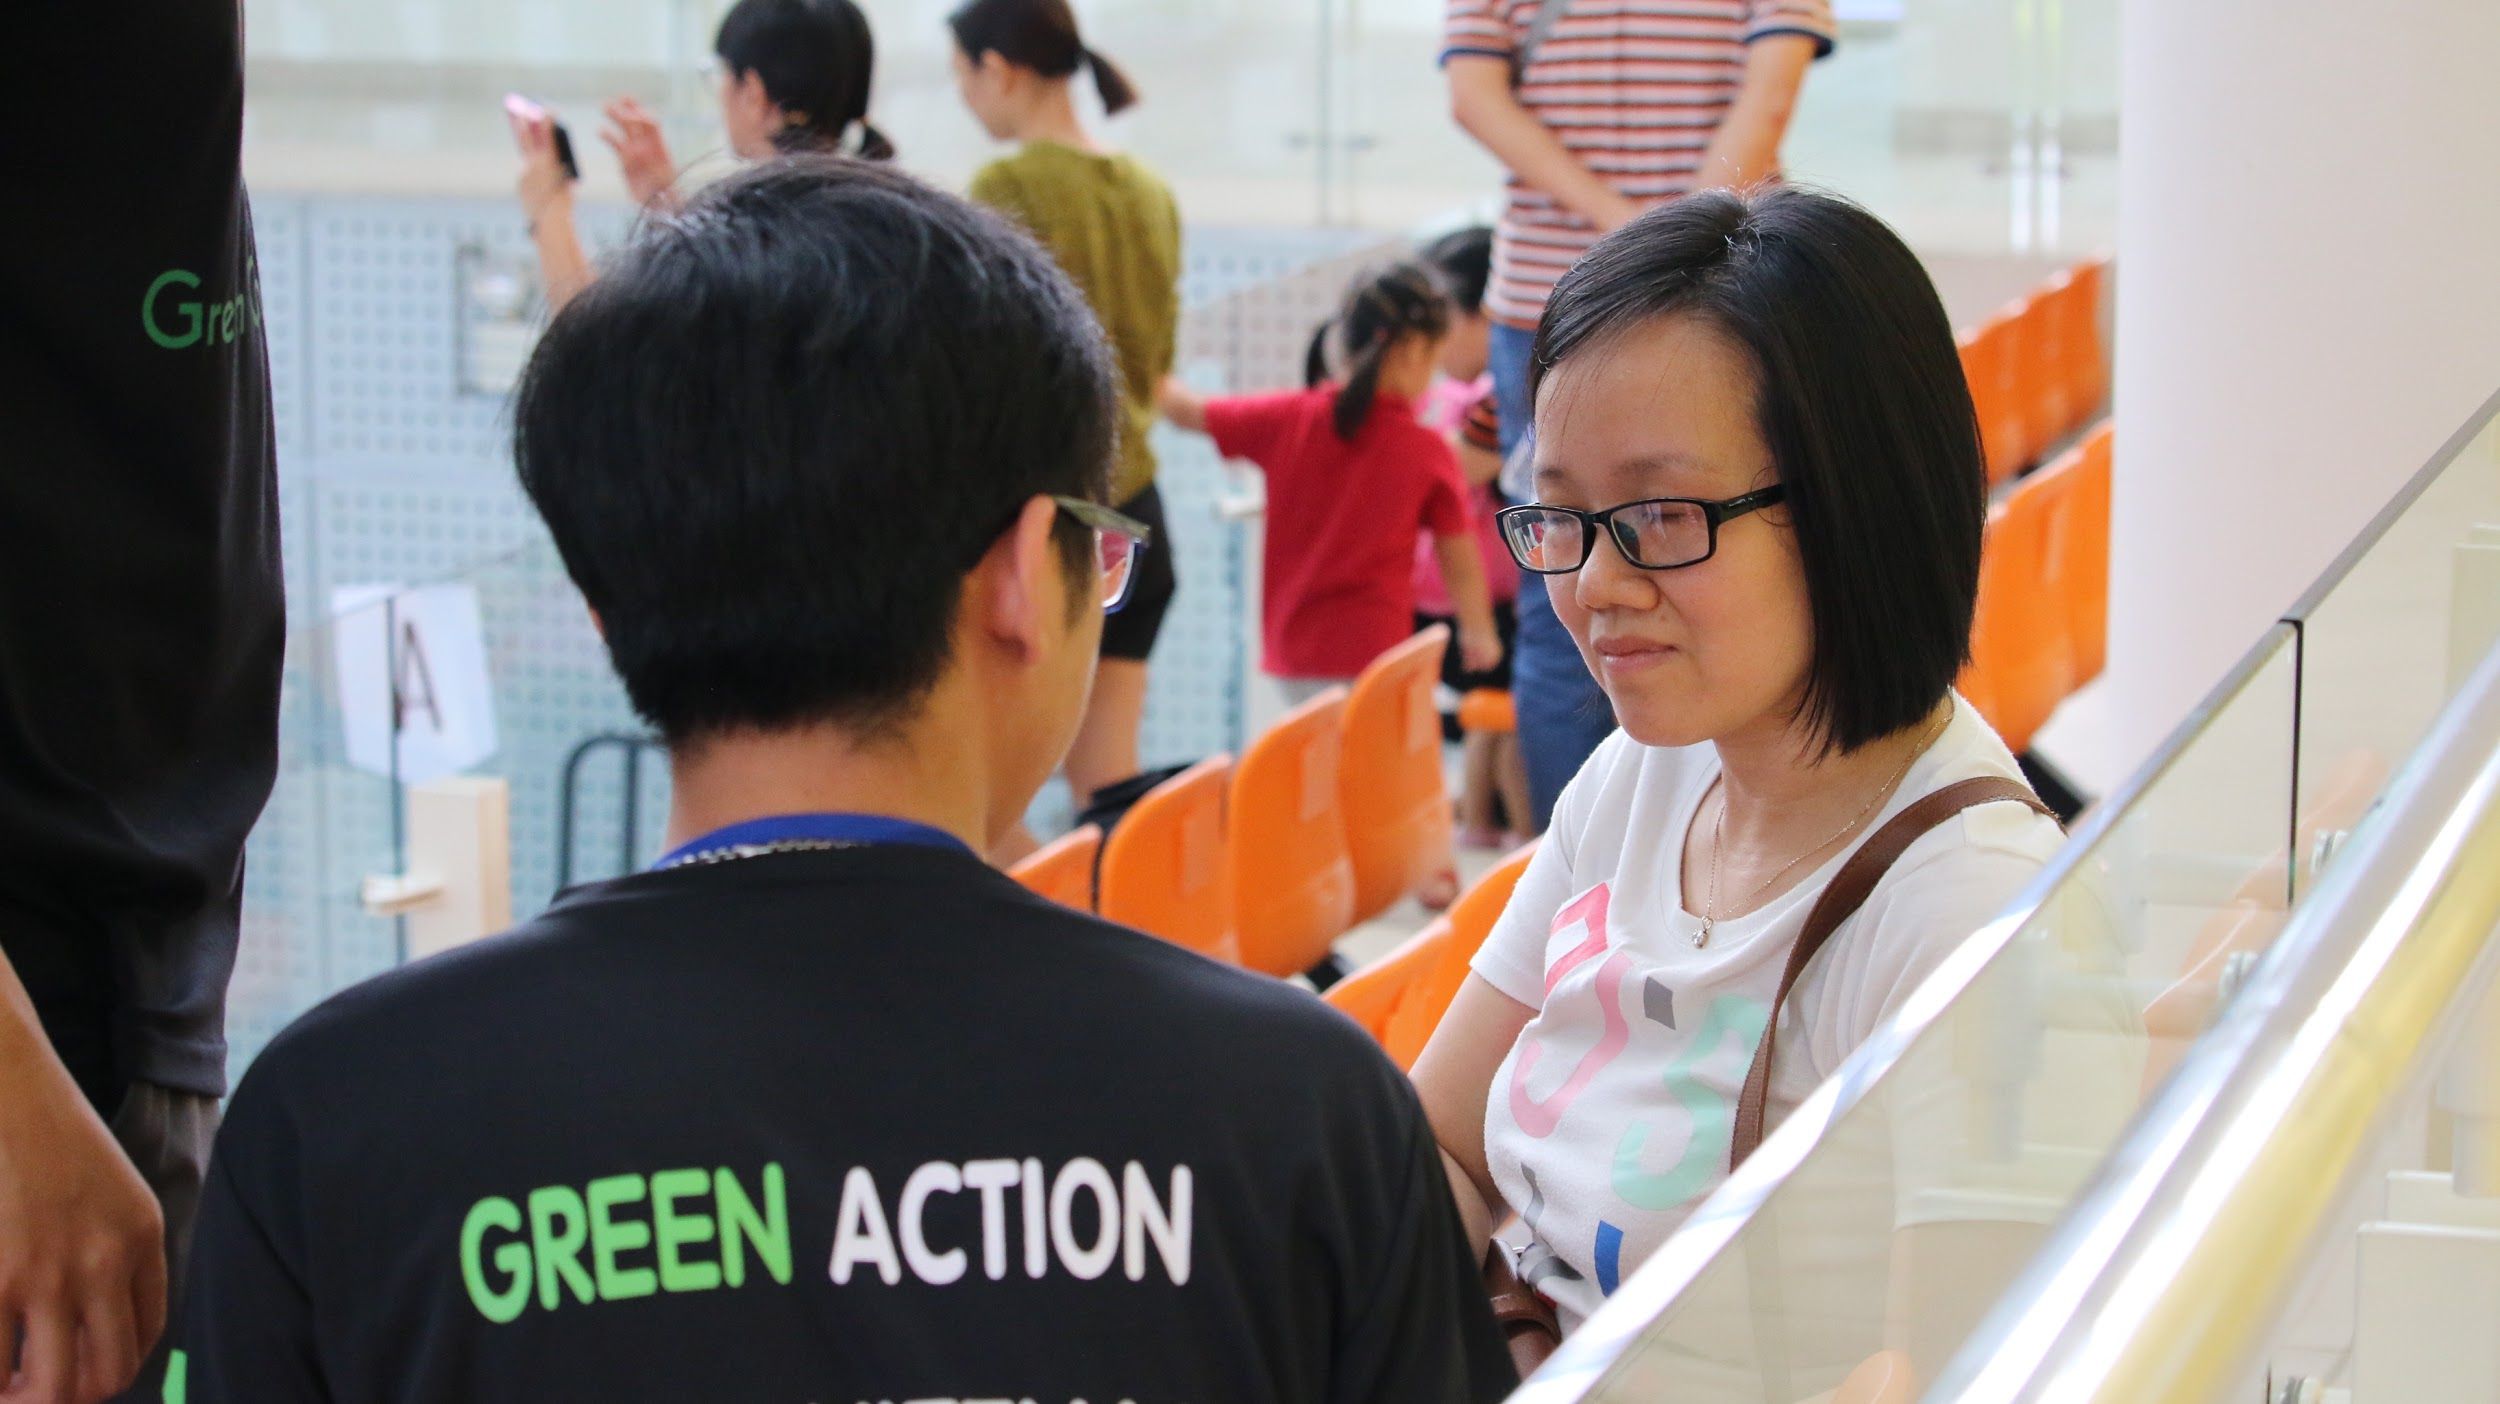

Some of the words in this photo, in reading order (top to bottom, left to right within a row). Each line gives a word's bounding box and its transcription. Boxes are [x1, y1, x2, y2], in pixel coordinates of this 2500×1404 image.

[392, 619, 443, 735] A
[459, 1161, 793, 1324] GREEN
[828, 1156, 1193, 1286] ACTION
